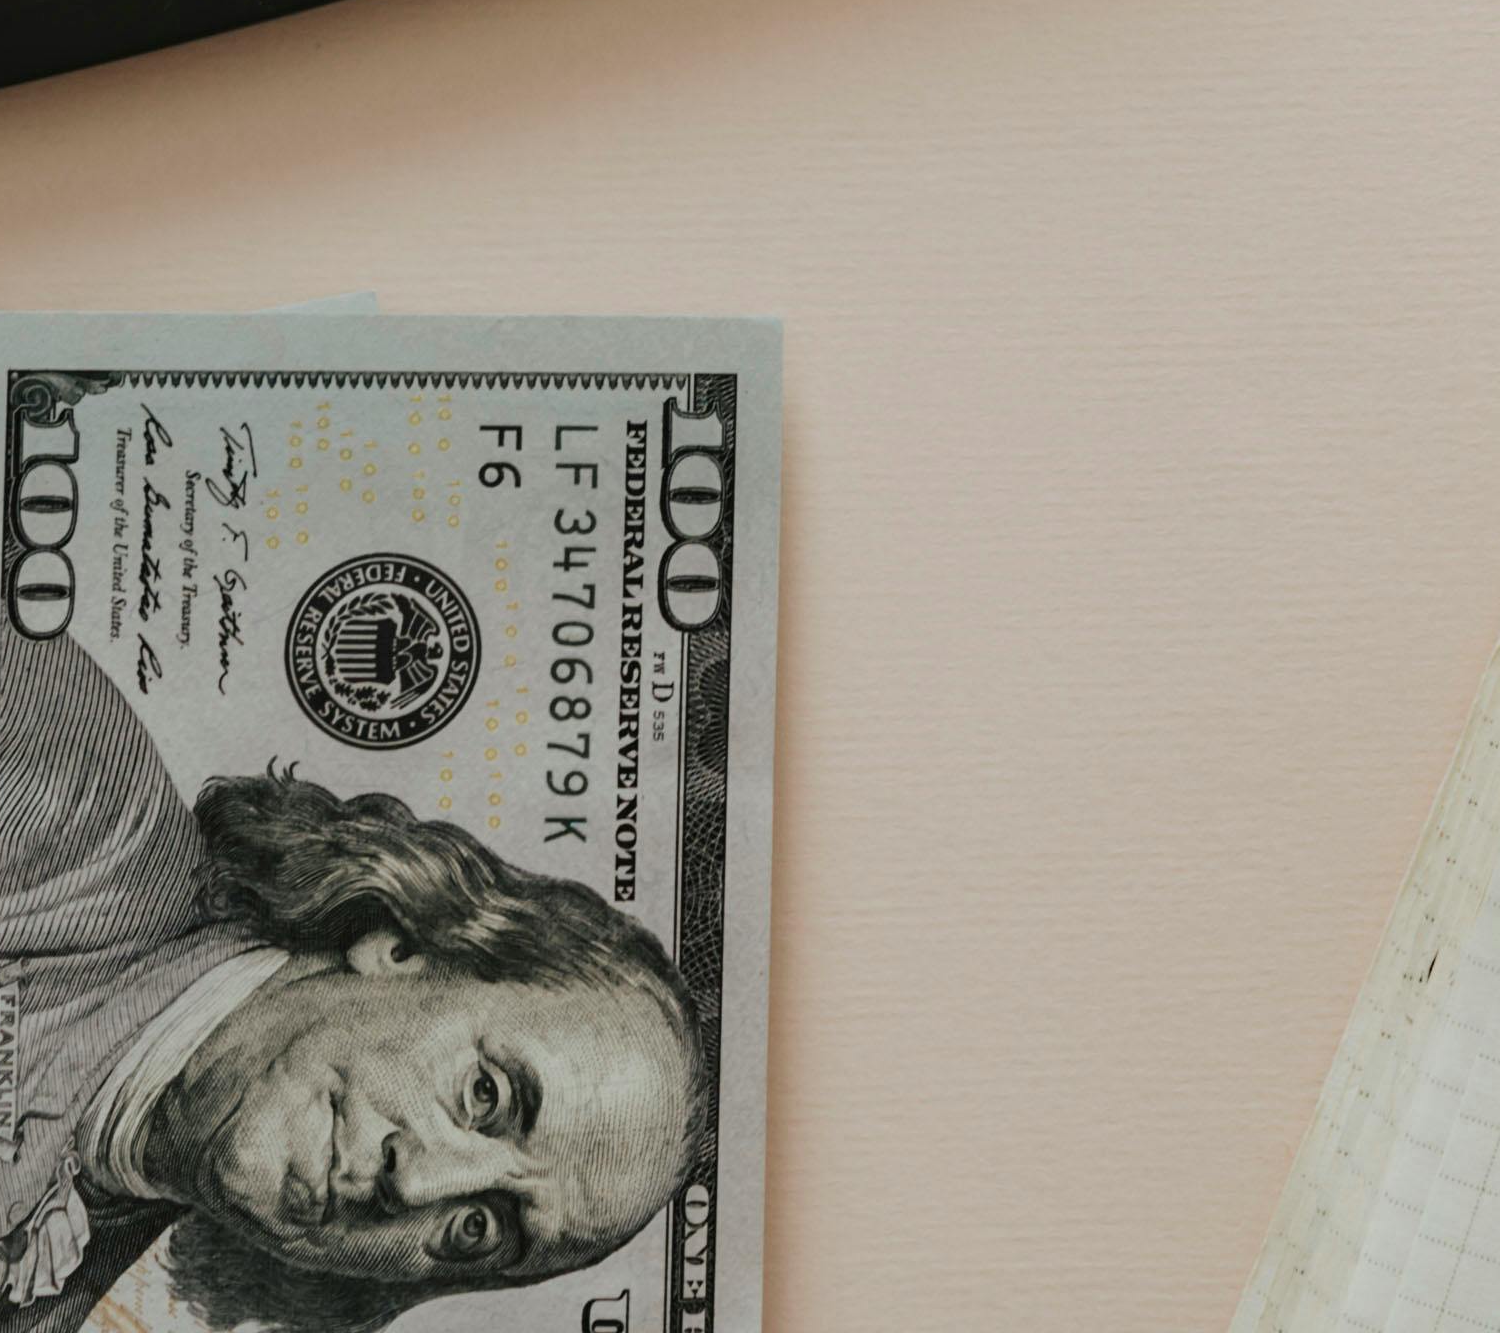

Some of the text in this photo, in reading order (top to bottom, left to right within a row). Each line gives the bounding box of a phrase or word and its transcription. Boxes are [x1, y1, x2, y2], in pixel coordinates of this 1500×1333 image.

[9, 404, 81, 641] 100
[476, 421, 524, 491] F6
[656, 396, 732, 633] 100
[542, 423, 599, 848] LF 34706879 K
